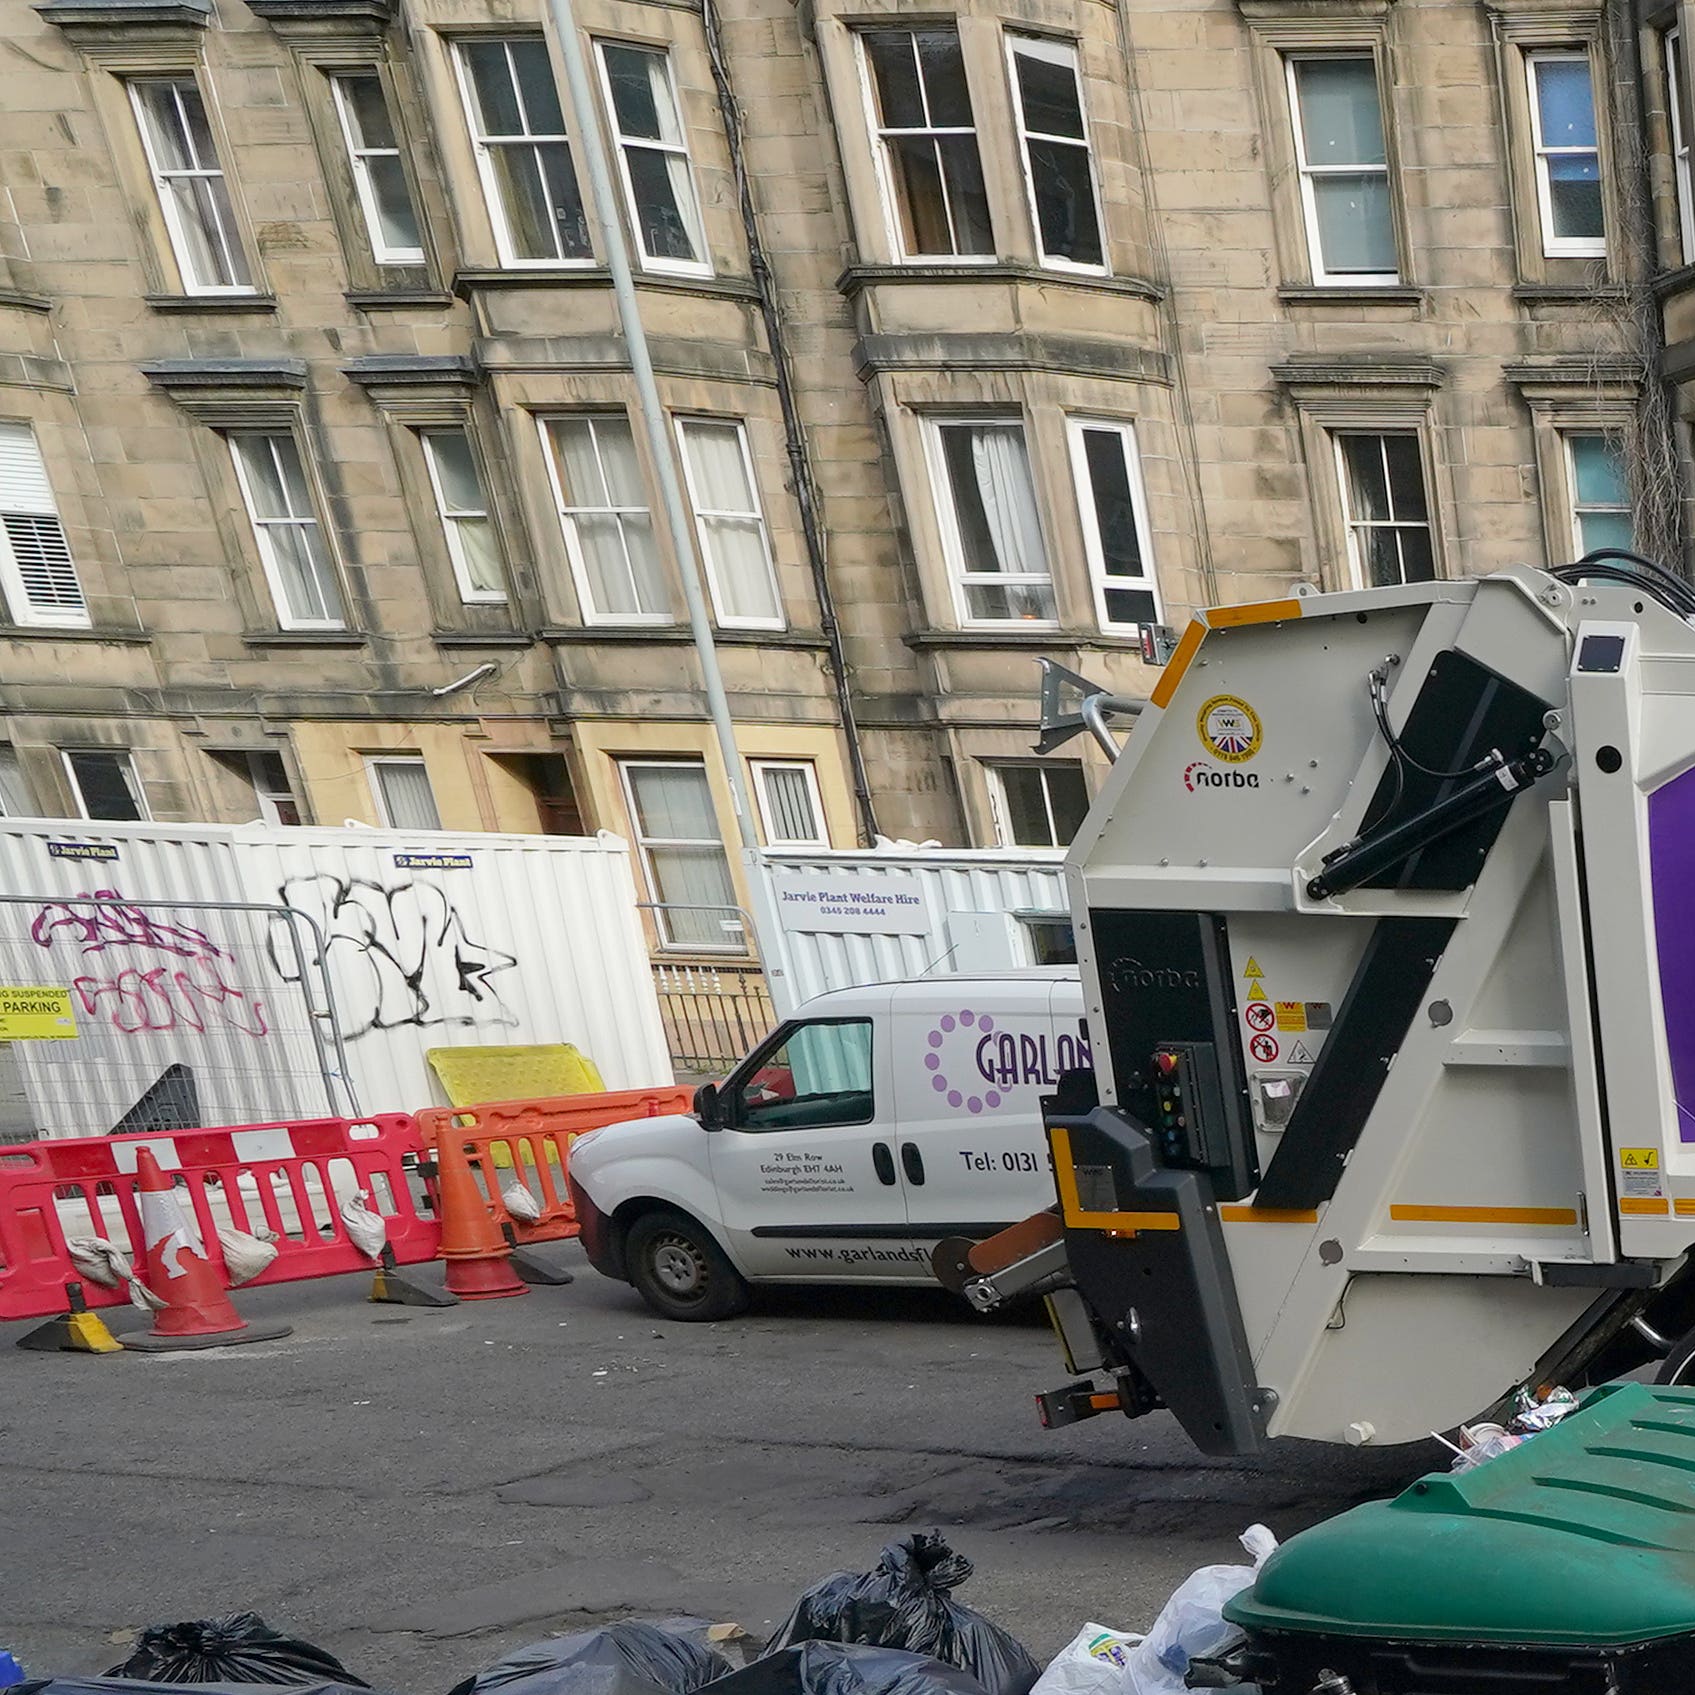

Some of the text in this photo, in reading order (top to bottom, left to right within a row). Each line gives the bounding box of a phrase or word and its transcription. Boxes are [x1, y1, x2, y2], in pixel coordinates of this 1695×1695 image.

[1196, 769, 1259, 788] norba
[782, 891, 920, 905] Jarvie Plant Welfare Hire
[11, 990, 68, 999] SUSPENDED
[3, 1001, 62, 1013] PARKING
[786, 1152, 802, 1162] Elm
[804, 1153, 823, 1162] Row
[959, 1151, 1038, 1172] Tel: 0131
[761, 1164, 802, 1176] Edinburgh
